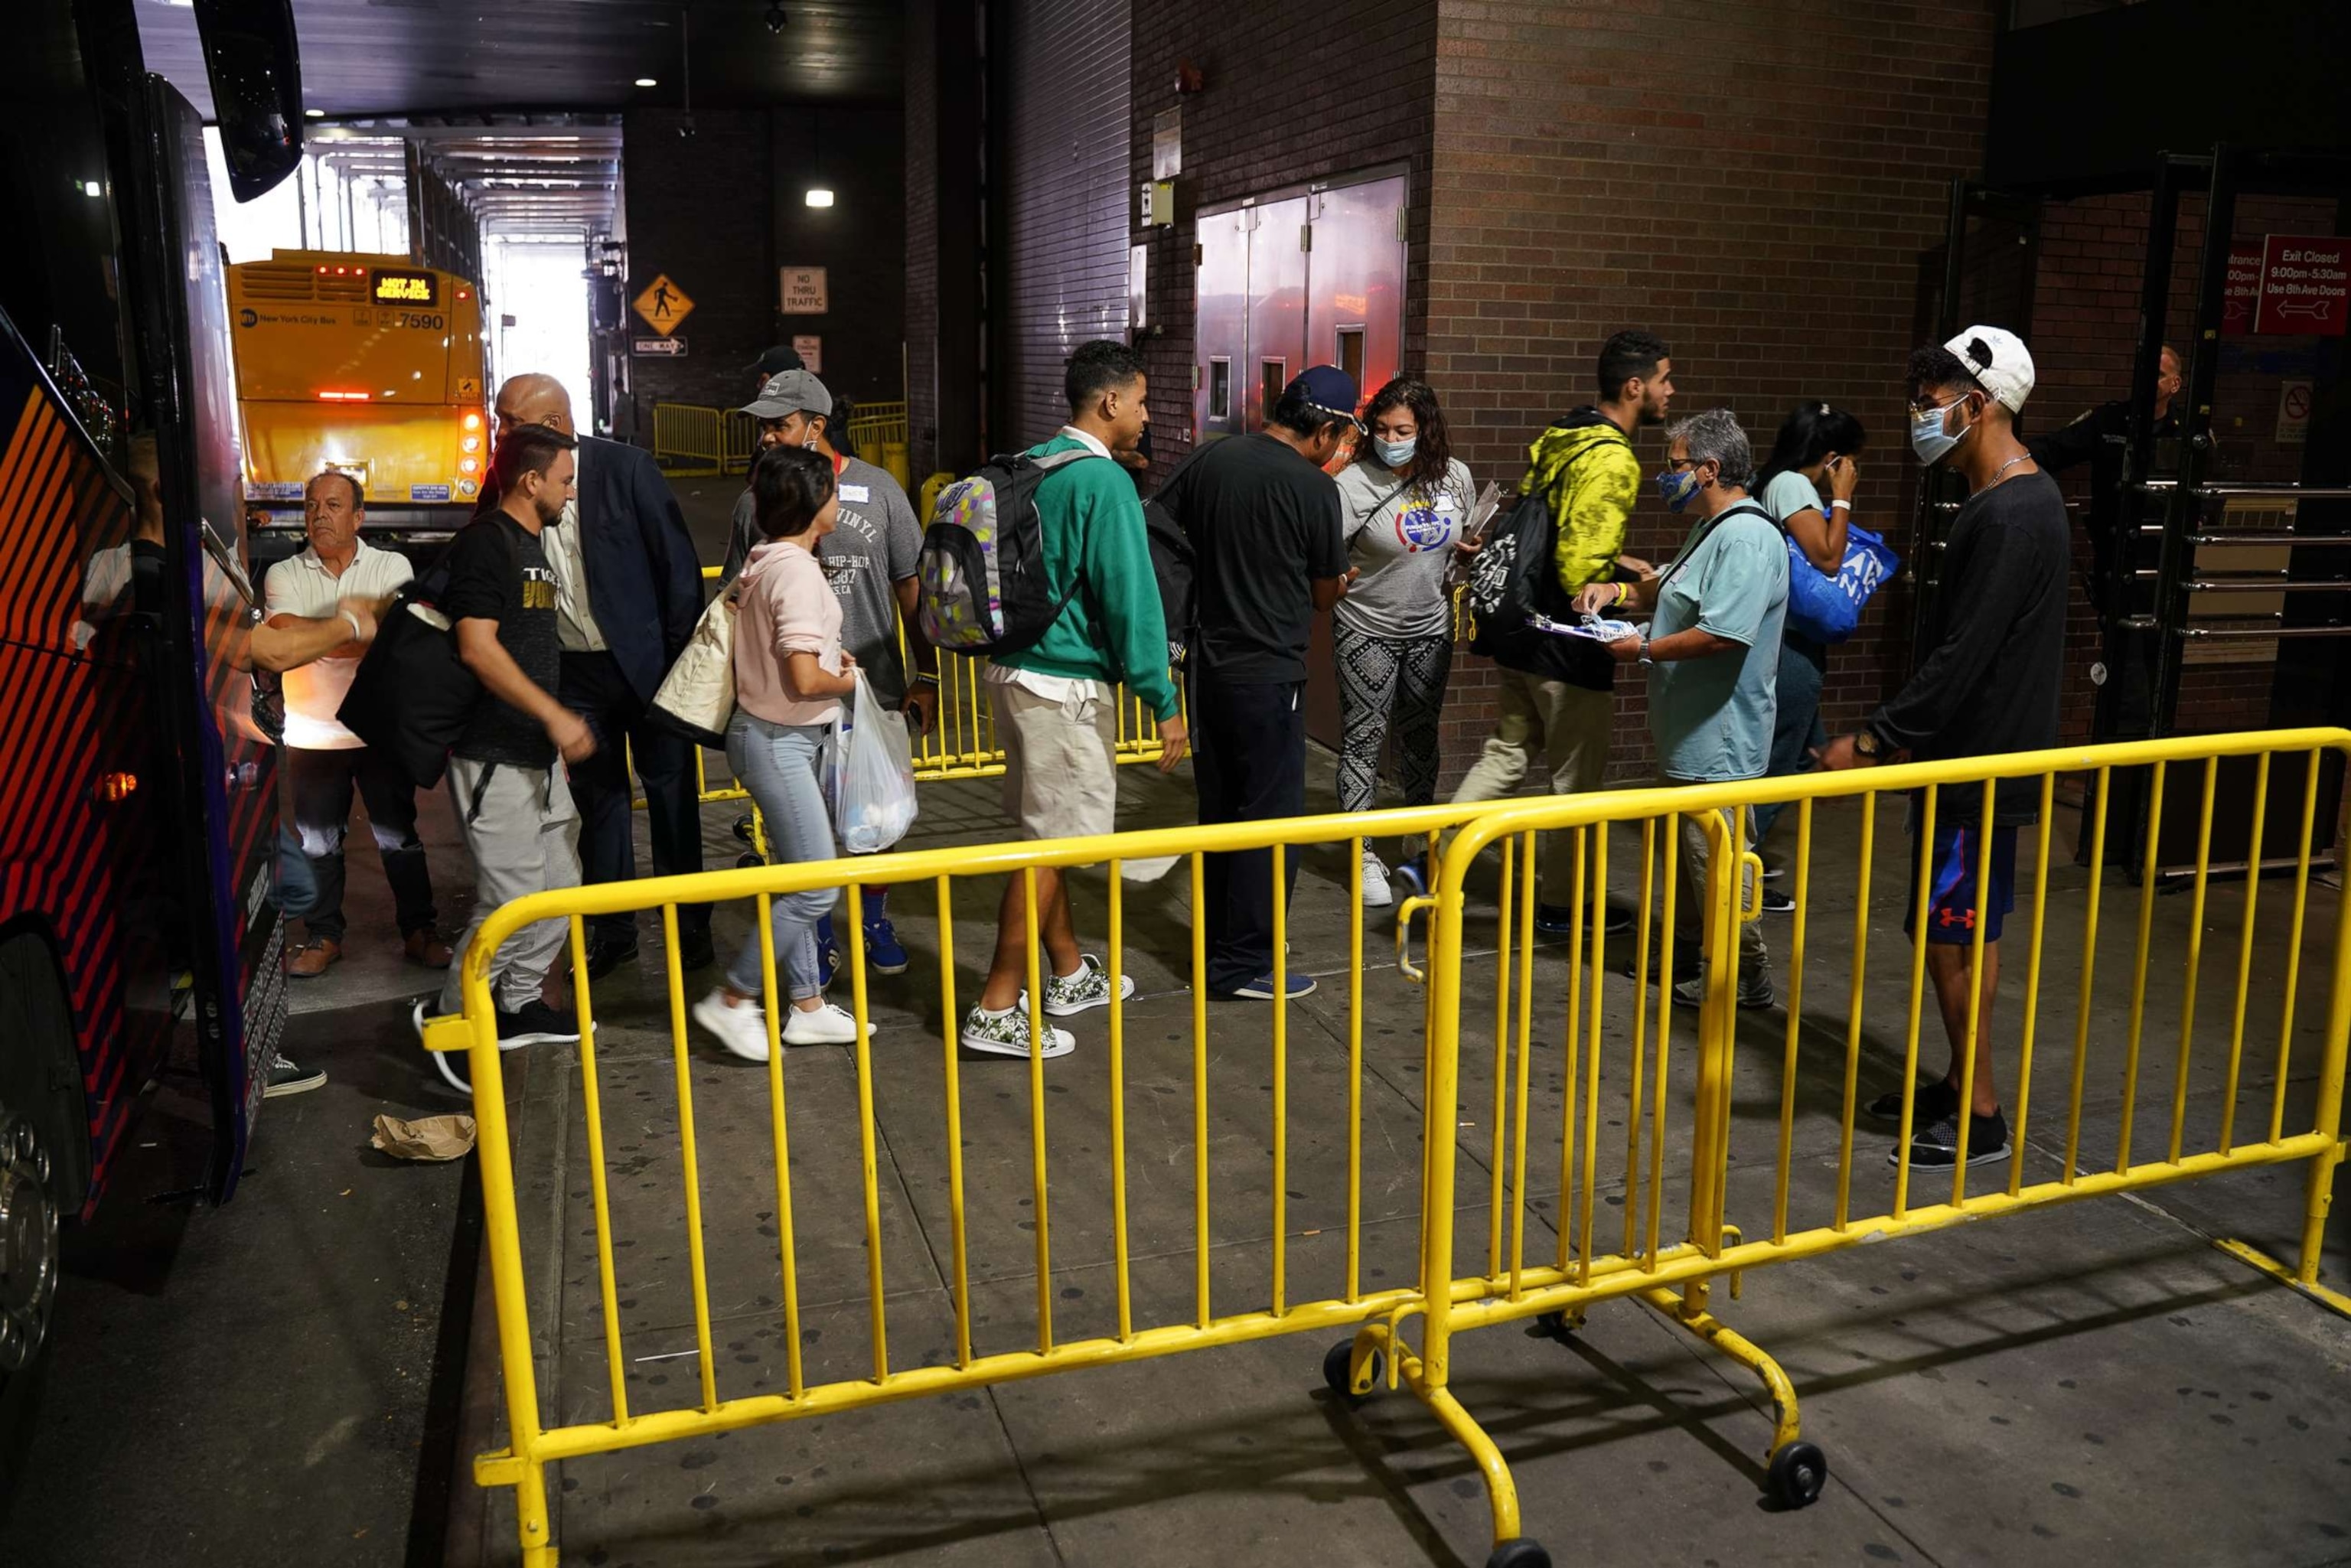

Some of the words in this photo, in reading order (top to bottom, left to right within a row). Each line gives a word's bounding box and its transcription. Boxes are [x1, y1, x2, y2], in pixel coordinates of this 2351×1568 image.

[2282, 249, 2301, 262] Exit
[2304, 250, 2340, 263] Closed
[382, 278, 407, 289] NOT
[409, 279, 426, 290] IN
[797, 275, 810, 283] NO
[377, 288, 429, 299] SERVICE
[793, 286, 817, 295] THRU
[2267, 282, 2285, 294] Use
[2285, 283, 2301, 295] 8th
[2301, 284, 2319, 295] Ave
[2319, 285, 2347, 296] Doors
[787, 298, 823, 306] TRAFFIC
[279, 315, 296, 324] York
[300, 315, 317, 325] City
[320, 316, 337, 324] Bus
[399, 312, 443, 330] 7590
[836, 507, 877, 543] VINYL
[828, 555, 869, 569] HIP-HOP
